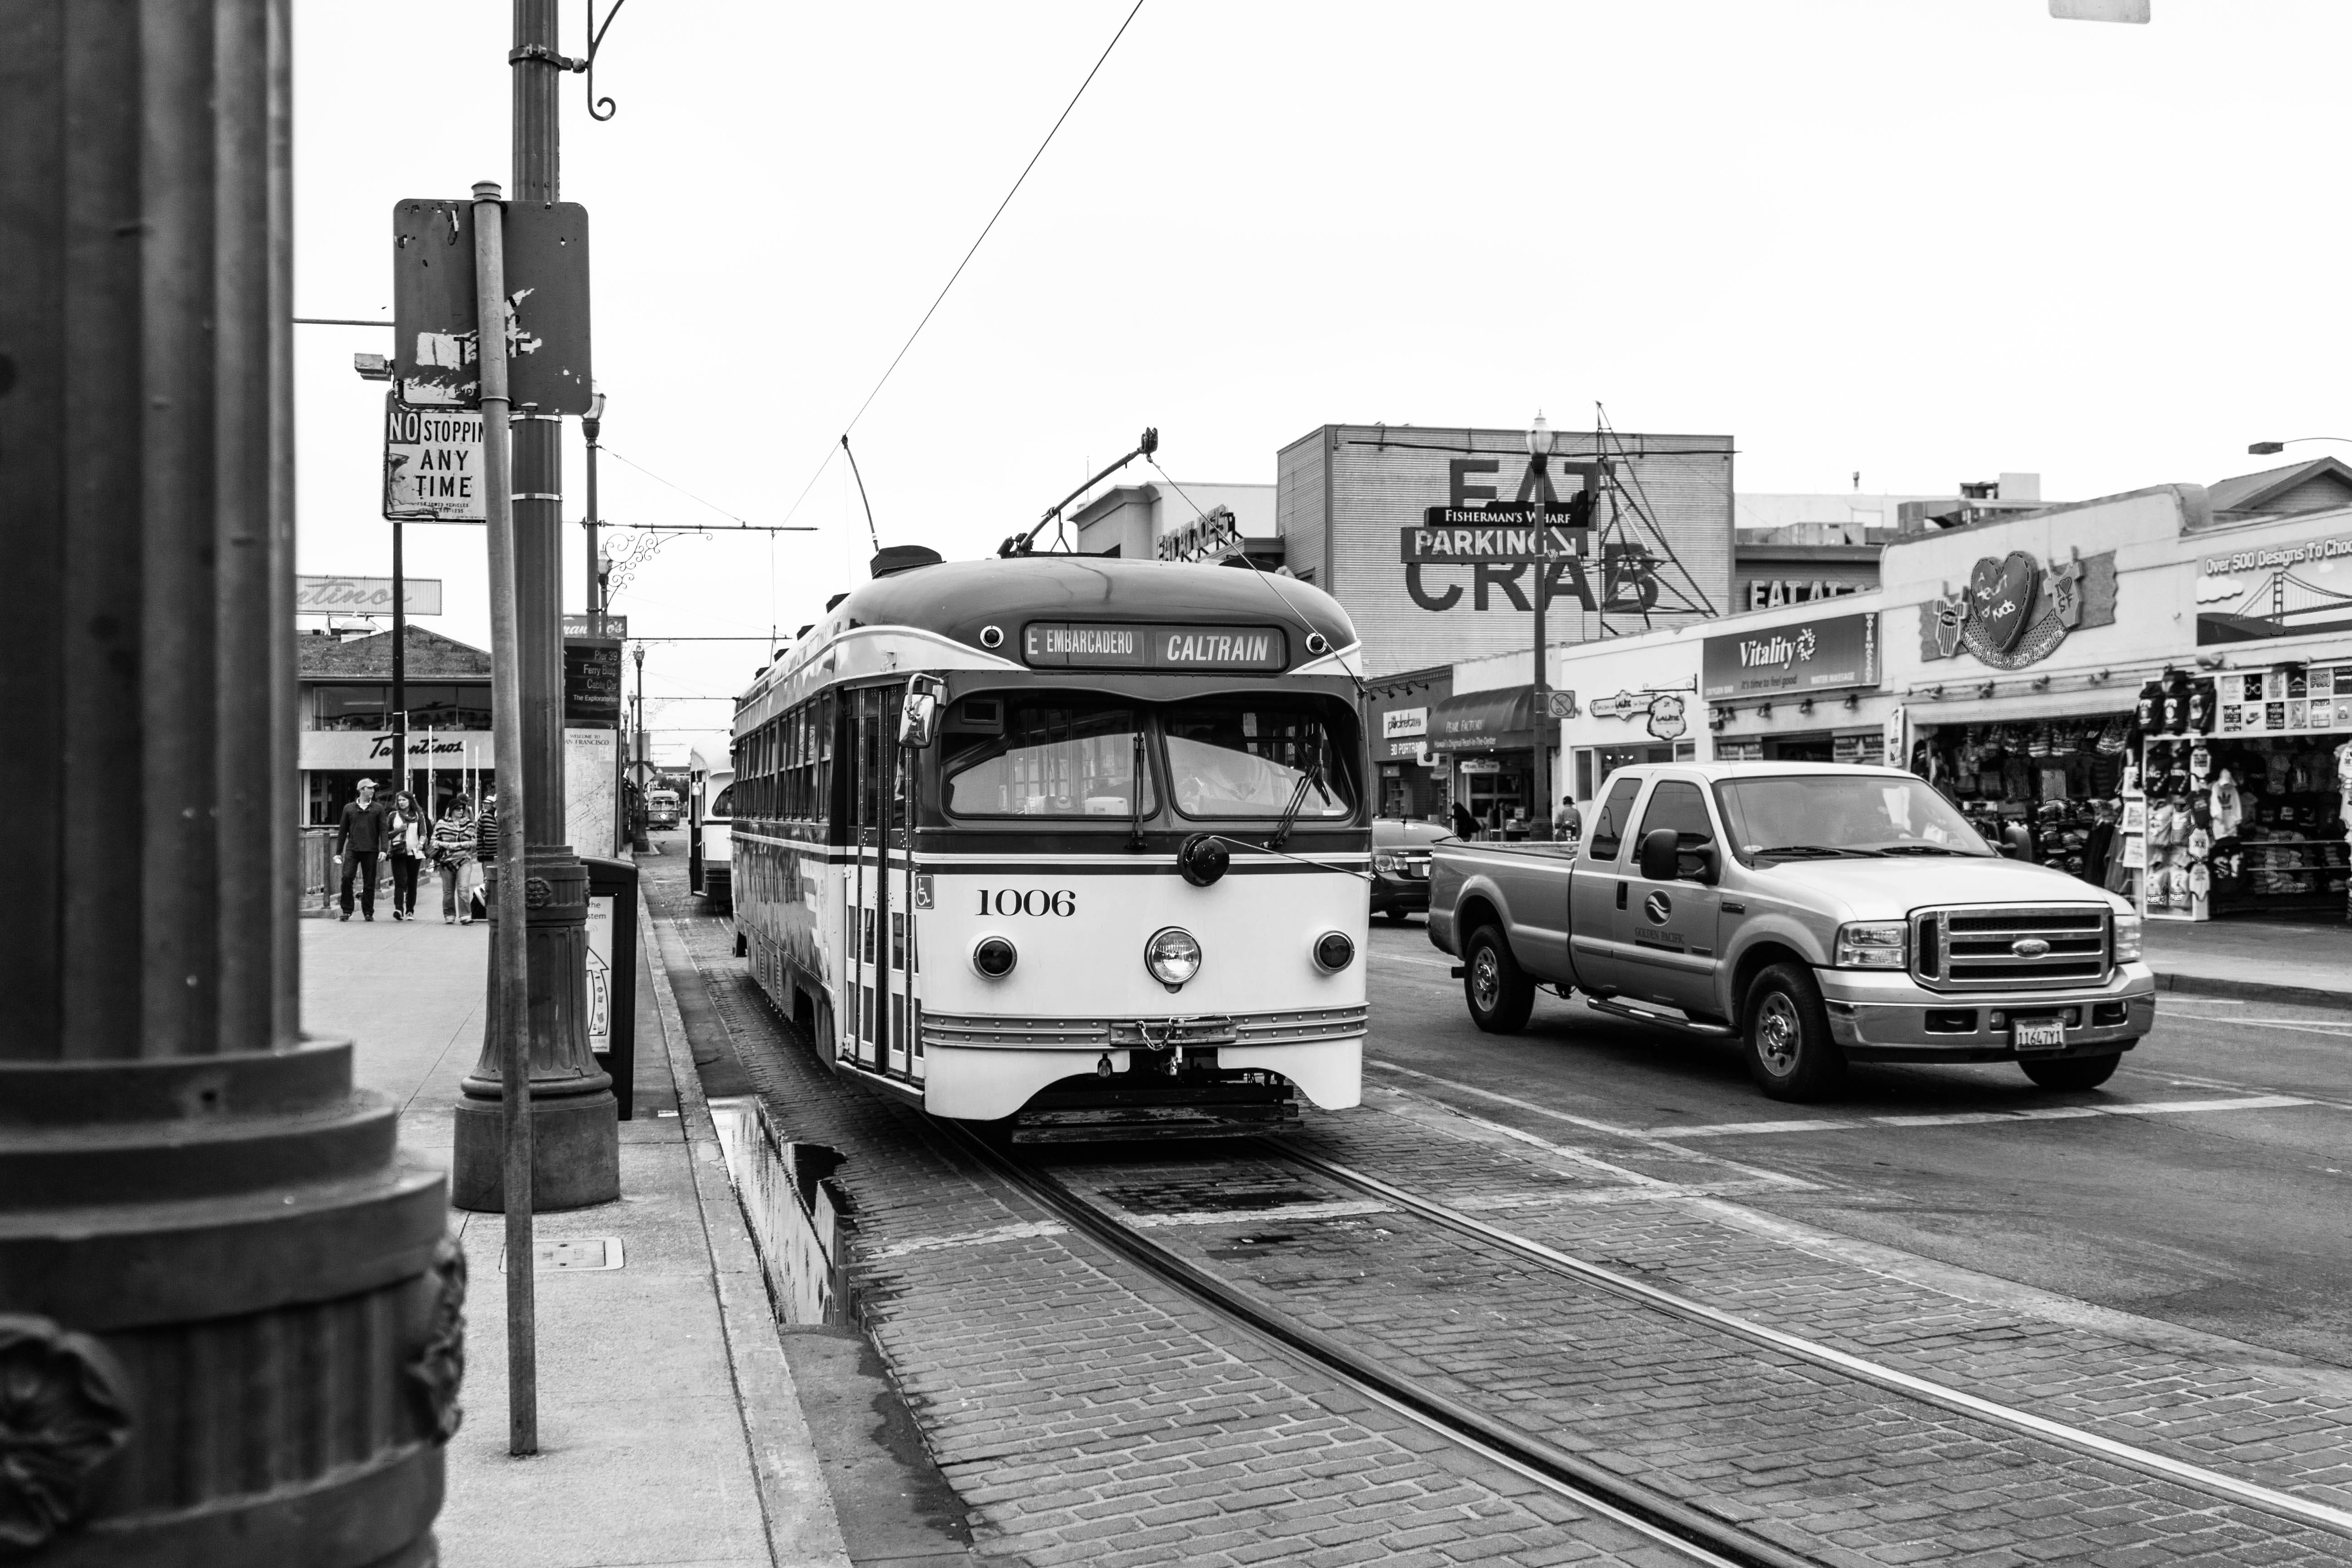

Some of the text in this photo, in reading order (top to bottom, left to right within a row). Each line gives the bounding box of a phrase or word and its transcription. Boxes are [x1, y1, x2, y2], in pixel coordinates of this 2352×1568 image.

[389, 412, 483, 443] NO STOPPIN
[420, 449, 469, 470] ANY
[415, 475, 471, 497] TIME
[1445, 510, 1523, 524] FISHERMAN'S
[2205, 559, 2230, 574] Over
[2232, 552, 2254, 570] 500
[2258, 548, 2304, 566] Designs
[2306, 542, 2323, 559] To
[1750, 580, 1802, 612] EAT
[2058, 593, 2073, 614] SF
[594, 650, 617, 661] Pier 39
[1027, 628, 1269, 662] E EMBARCADERO CALTRAIN
[1740, 636, 1797, 670] Vitality
[583, 664, 600, 676] Ferry
[587, 679, 617, 690] Cable Car
[1391, 744, 1397, 755] 3D
[975, 889, 1076, 917] 1006
[1635, 927, 1685, 944] GOLDEN PACIFIC
[2018, 1030, 2061, 1045] 11647Y1
